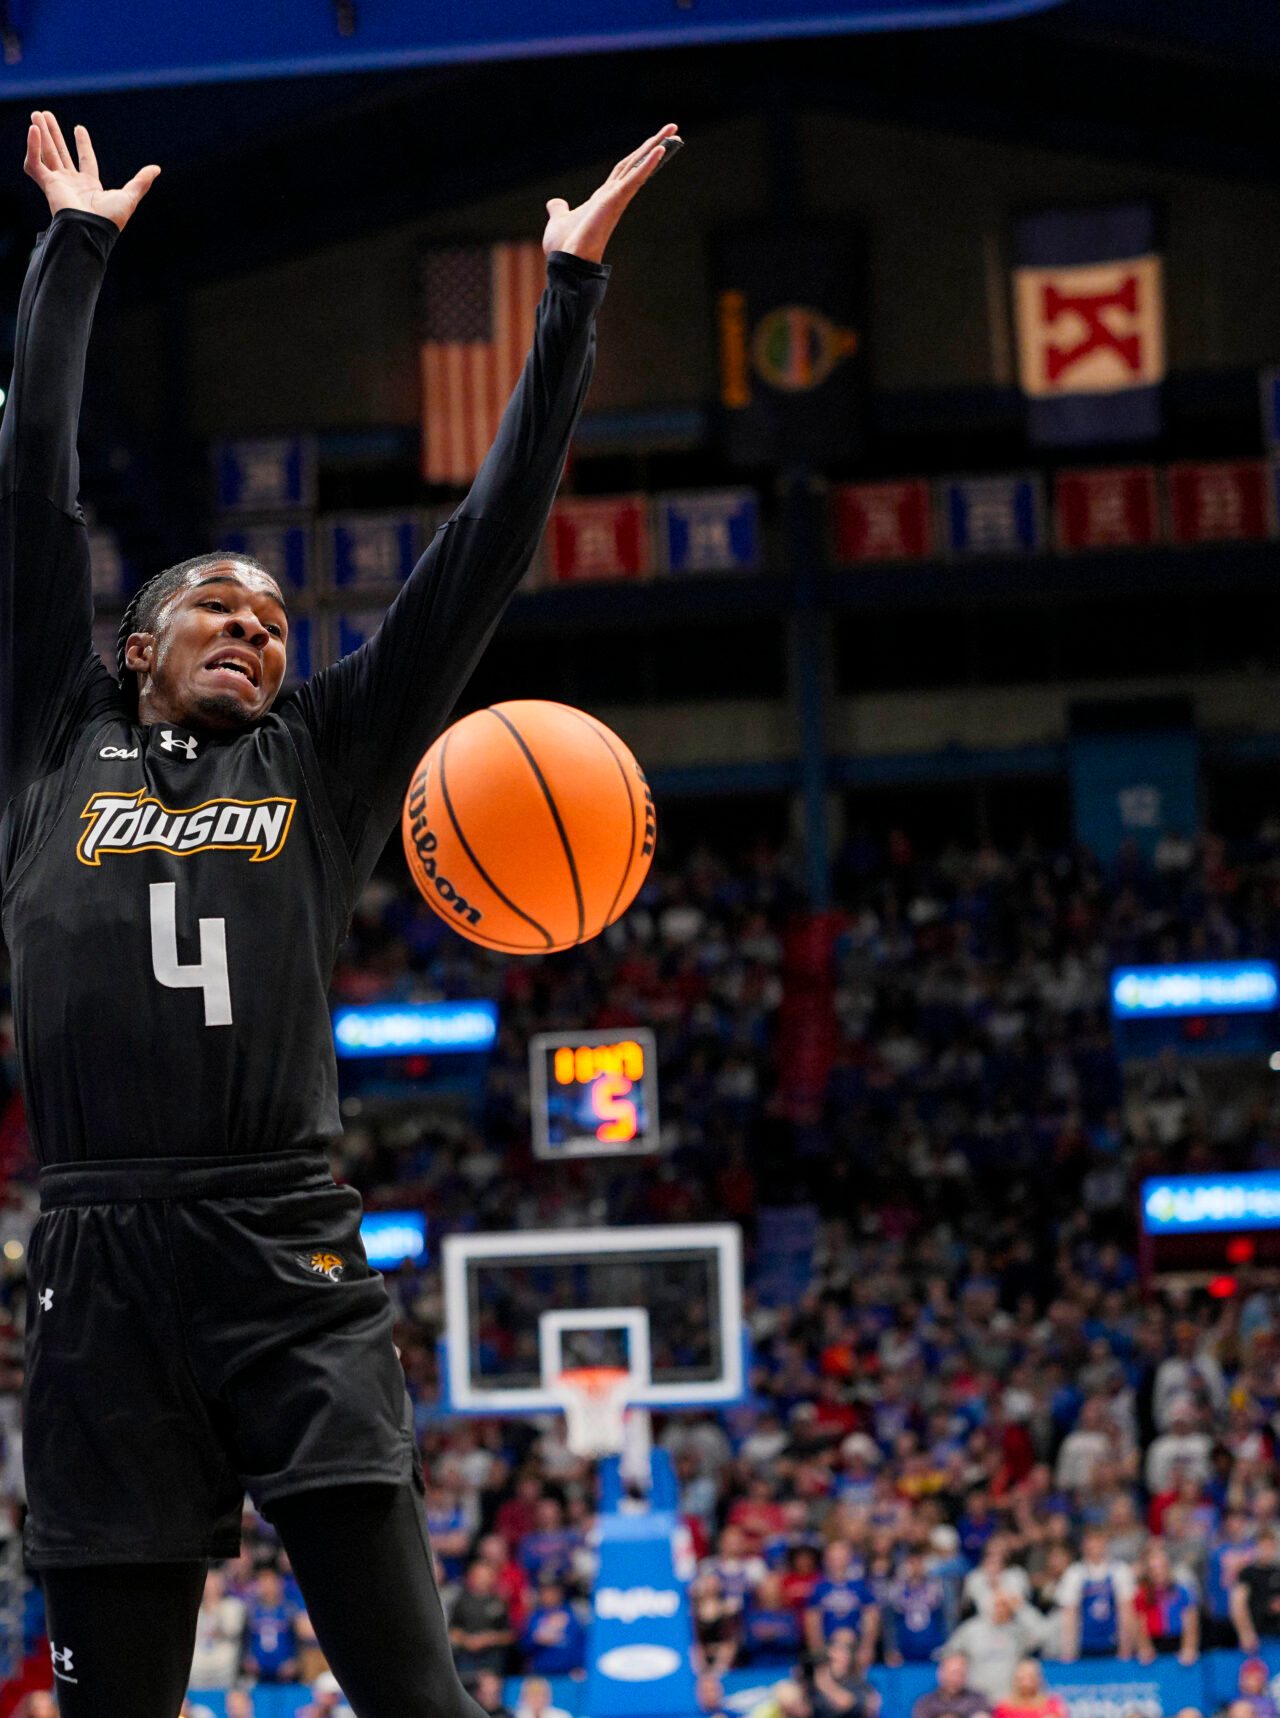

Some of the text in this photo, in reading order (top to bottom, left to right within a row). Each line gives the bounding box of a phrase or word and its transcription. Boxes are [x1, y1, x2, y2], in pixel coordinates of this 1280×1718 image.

[99, 746, 139, 759] CAA
[149, 882, 233, 1026] 4
[592, 1076, 637, 1142] 5
